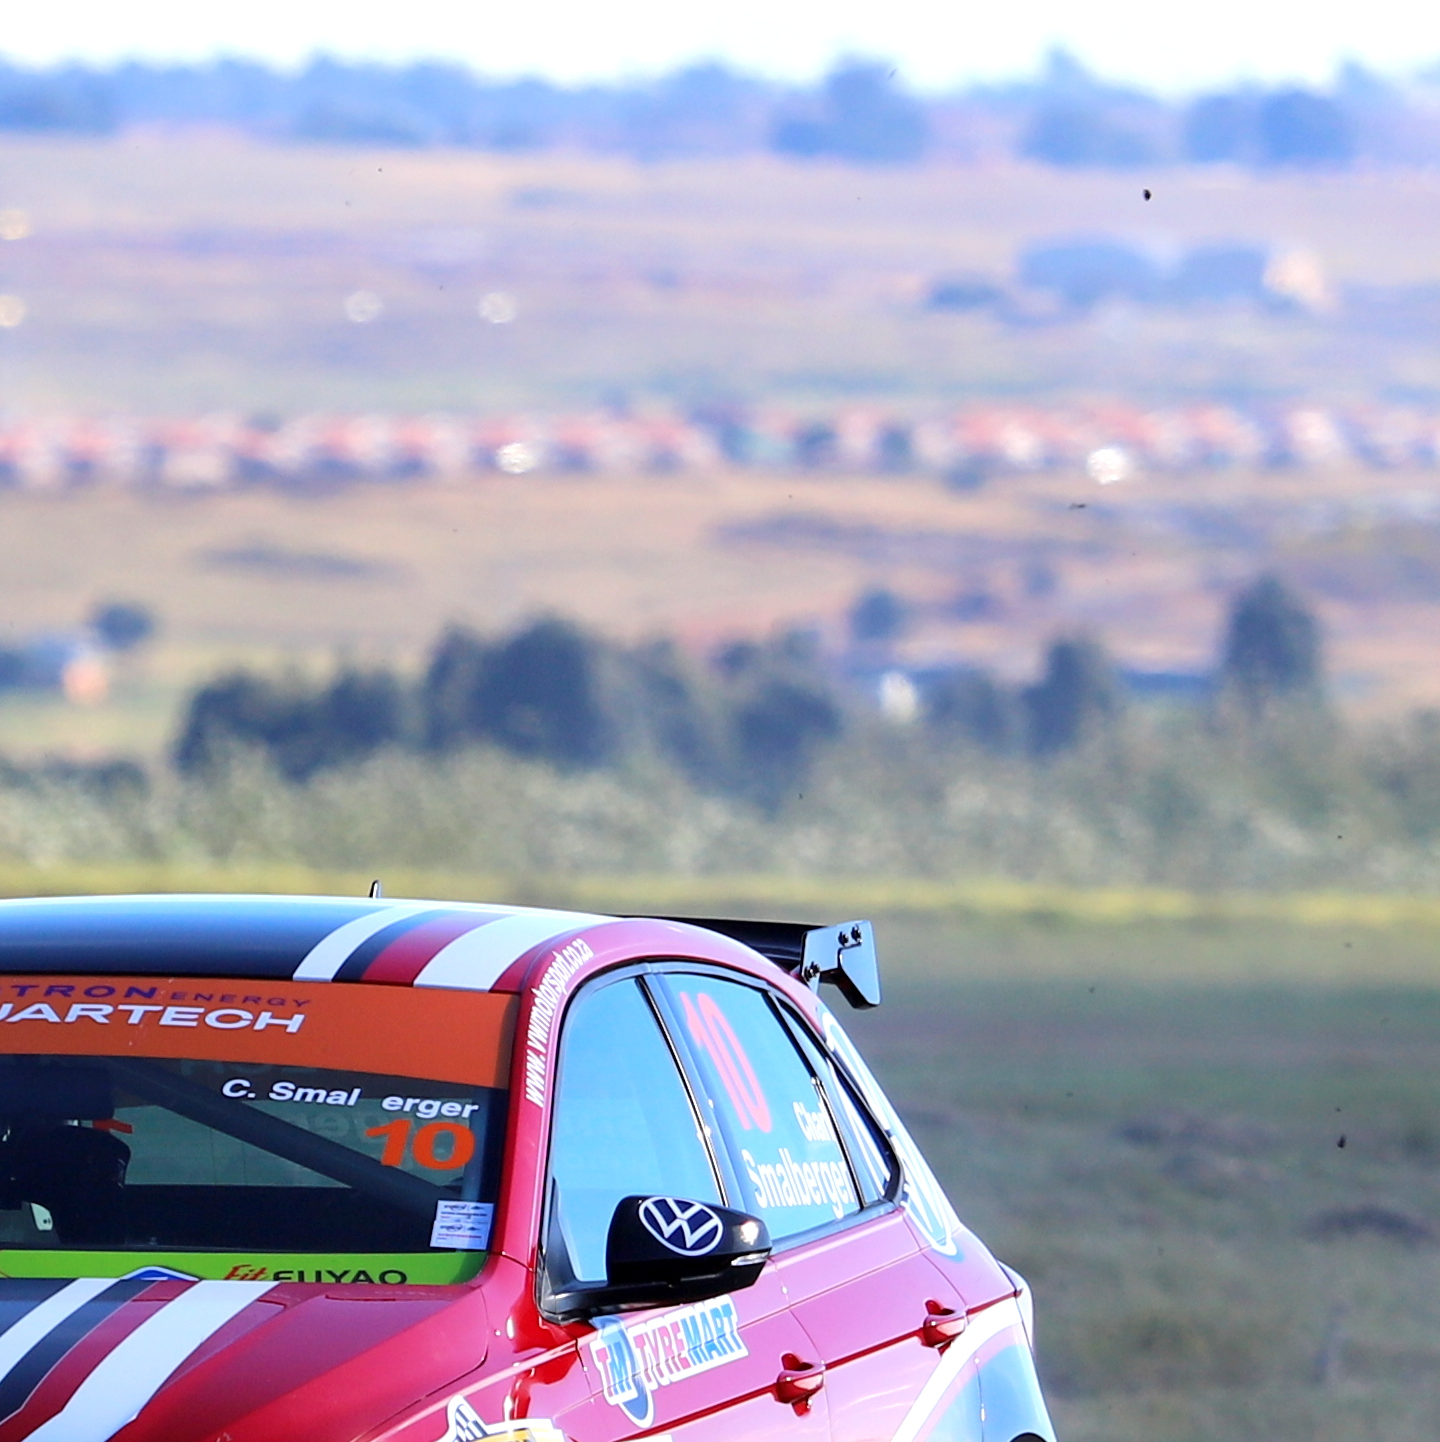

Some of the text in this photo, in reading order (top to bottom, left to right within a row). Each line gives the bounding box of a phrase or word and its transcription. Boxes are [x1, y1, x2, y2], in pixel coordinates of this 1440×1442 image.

[169, 991, 313, 1009] ENERGY
[222, 1078, 256, 1098] C.
[364, 1119, 476, 1171] 10
[741, 1148, 855, 1219] Smalberger
[632, 1303, 744, 1384] TYREMART
